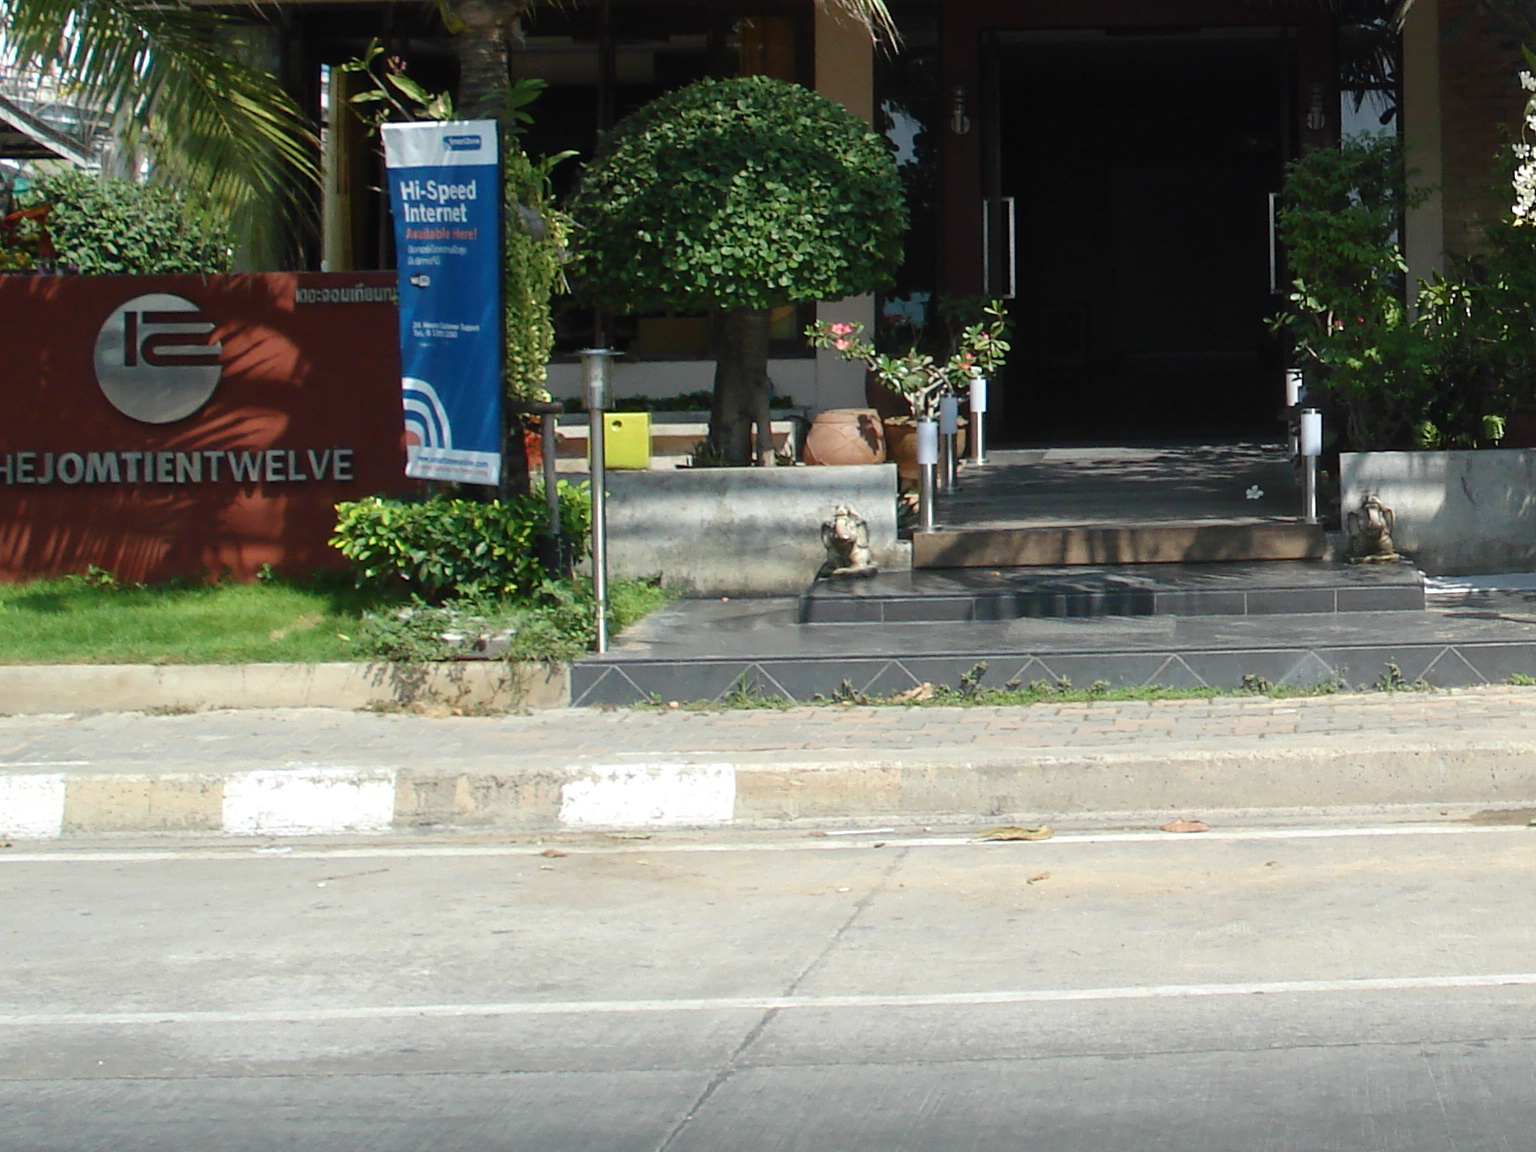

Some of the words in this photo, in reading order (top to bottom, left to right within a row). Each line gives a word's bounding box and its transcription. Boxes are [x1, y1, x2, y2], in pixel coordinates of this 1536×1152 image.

[400, 179, 477, 204] Hi-Speed
[403, 203, 467, 222] Internet
[406, 227, 450, 239] Available
[453, 228, 478, 240] Here!
